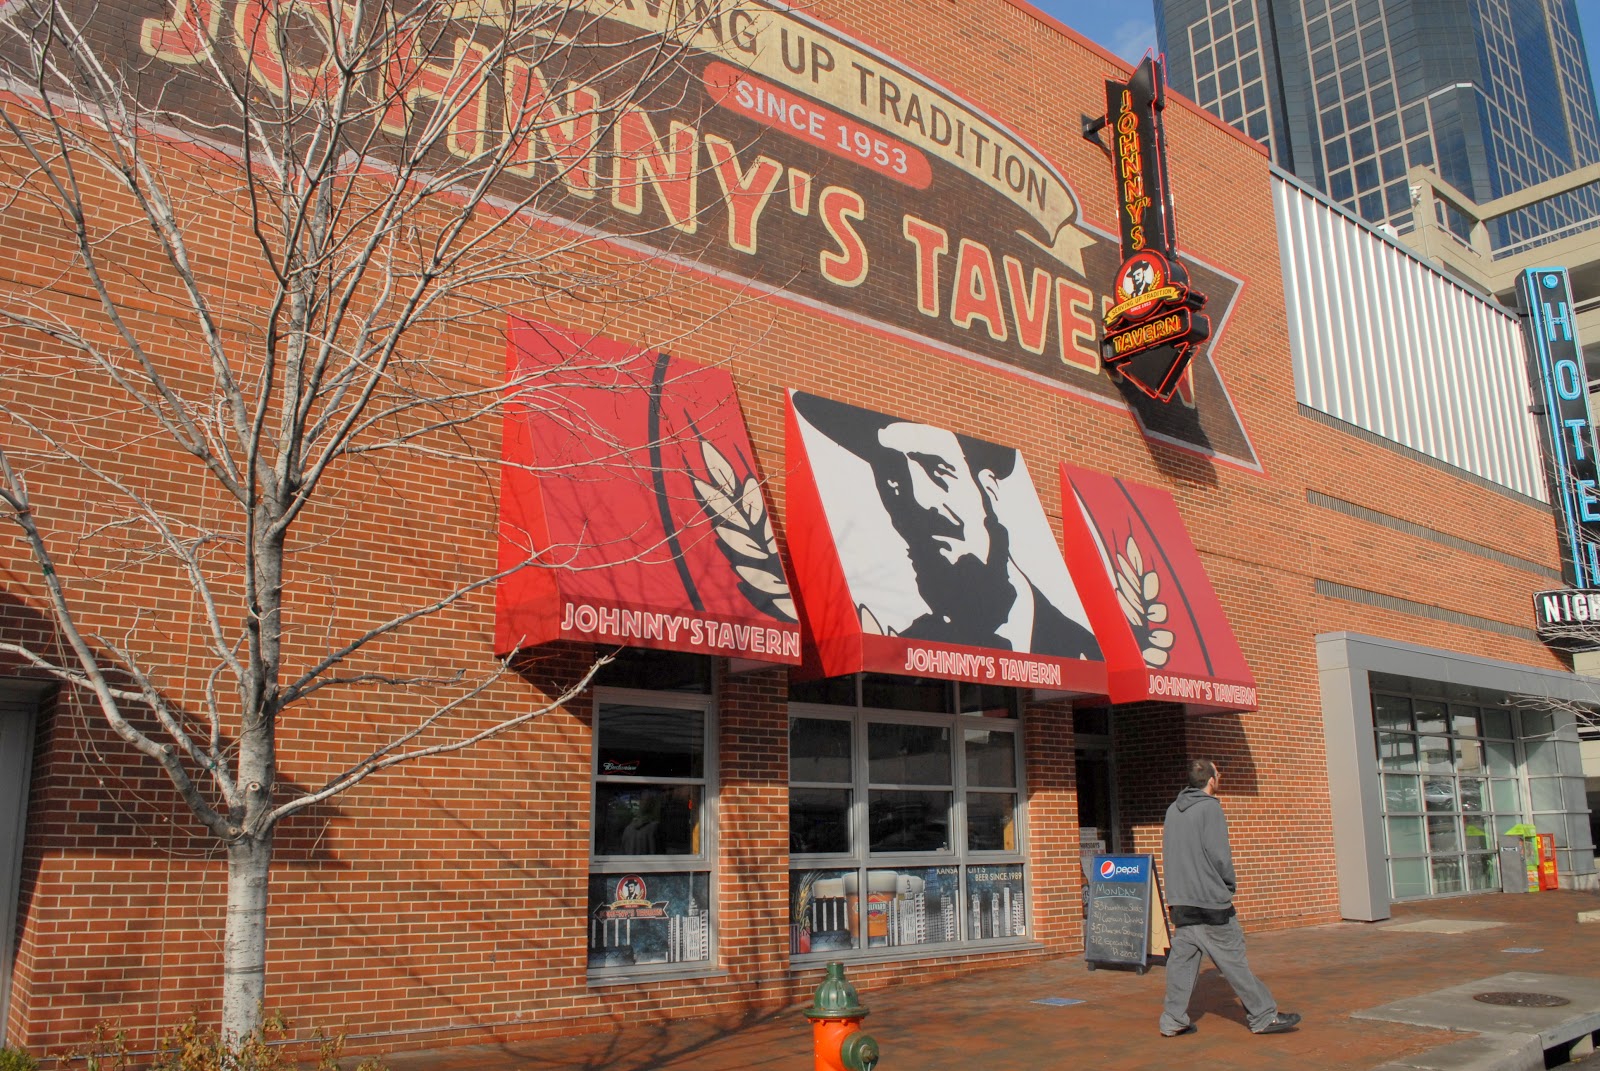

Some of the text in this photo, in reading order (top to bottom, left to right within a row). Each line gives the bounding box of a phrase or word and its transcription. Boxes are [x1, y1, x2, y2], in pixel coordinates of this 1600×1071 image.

[735, 80, 908, 174] SINCE 1953
[781, 27, 835, 84] UP
[851, 61, 1047, 212] TRADITION
[1118, 89, 1151, 250] JOHNNY'S
[902, 213, 1195, 408] TAVE
[1111, 300, 1134, 315] SERVING
[1144, 288, 1172, 300] TRADITION
[1113, 314, 1181, 353] TAVERN
[905, 647, 1061, 686] JOHNNY'S TAVERN
[1148, 674, 1257, 706] JOHNNY'S TAVERN
[936, 867, 958, 875] KANSA
[975, 872, 1022, 882] BEER SINCE 1989
[1115, 865, 1139, 875] pepsi
[1096, 883, 1136, 897] MONDAY
